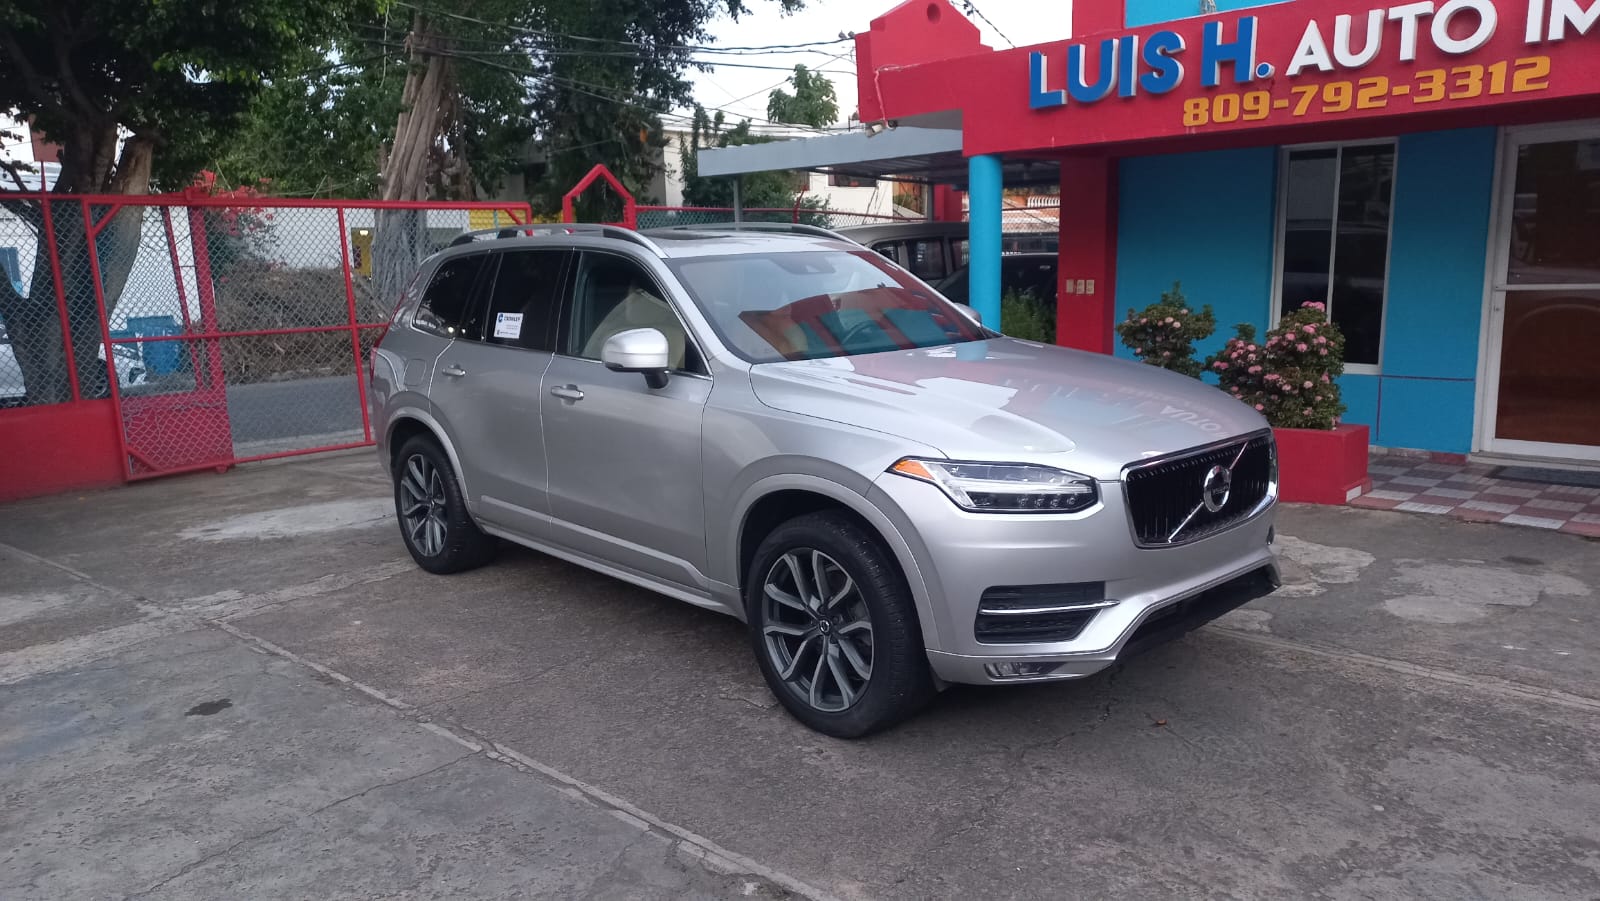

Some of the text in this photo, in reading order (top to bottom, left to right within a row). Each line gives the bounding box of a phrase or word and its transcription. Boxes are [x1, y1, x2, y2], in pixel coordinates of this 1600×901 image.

[1029, 30, 1186, 109] LUIS
[1200, 15, 1275, 87] H.
[1285, 0, 1497, 76] AUTO
[1183, 56, 1551, 127] 809-792-3312
